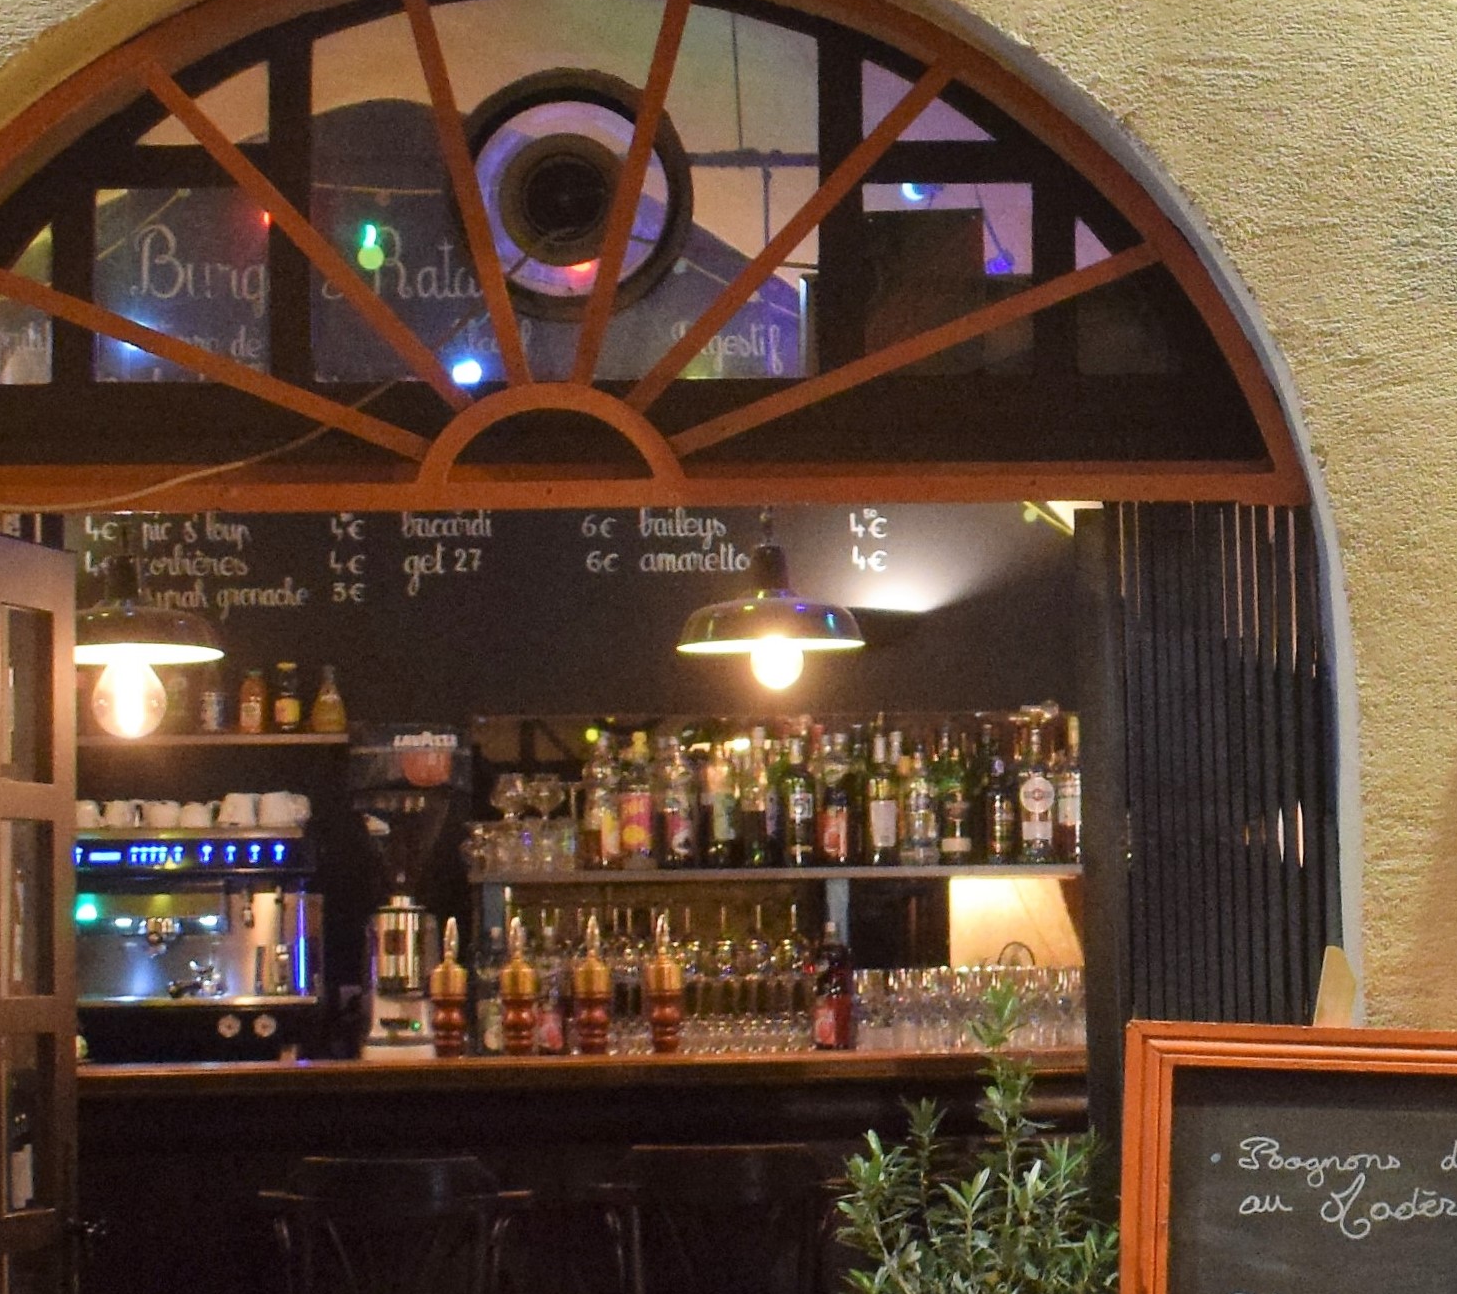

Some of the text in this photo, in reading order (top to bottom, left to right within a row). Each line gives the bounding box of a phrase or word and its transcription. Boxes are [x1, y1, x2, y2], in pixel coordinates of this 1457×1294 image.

[130, 224, 270, 316] Burg
[671, 320, 783, 374] Dgestif
[581, 514, 617, 538] 6€
[639, 508, 727, 549] baileys
[454, 548, 481, 572] 27
[586, 552, 620, 573] 6€
[639, 545, 888, 573] amaretto 4€
[1238, 1136, 1400, 1187] Rognons
[1239, 1195, 1293, 1216] au
